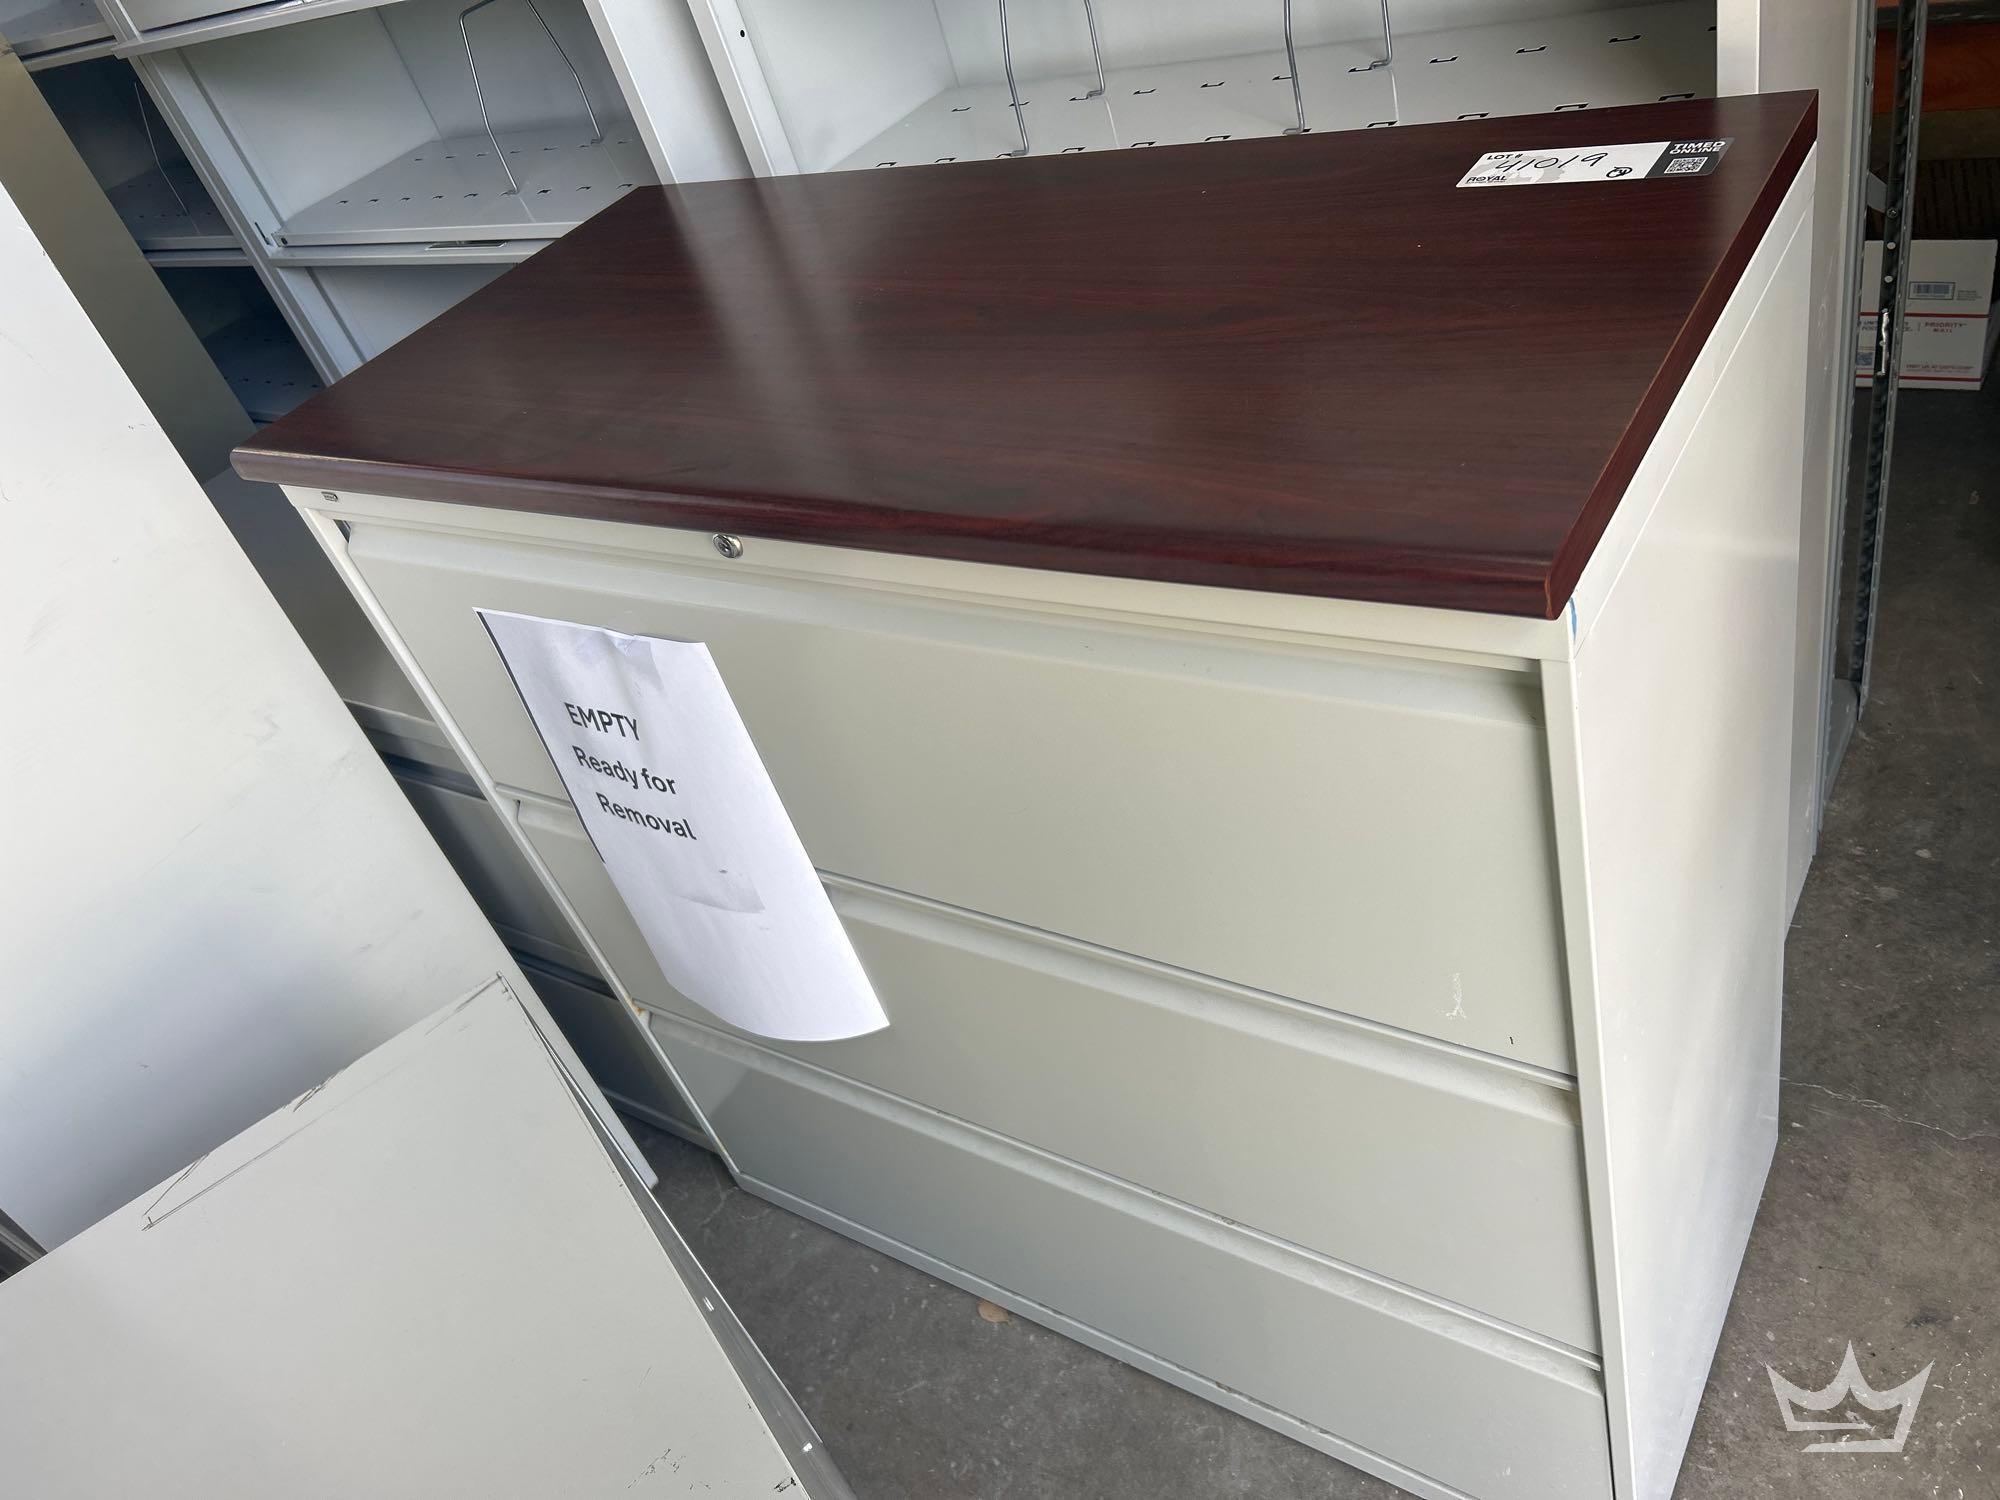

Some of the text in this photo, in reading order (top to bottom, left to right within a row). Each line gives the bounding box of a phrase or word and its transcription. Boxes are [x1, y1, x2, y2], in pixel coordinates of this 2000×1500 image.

[1669, 146, 1722, 155] ONLINE
[1673, 141, 1726, 150] TIMED
[1486, 153, 1514, 161] LOT
[1495, 152, 1608, 173] 41019
[1466, 175, 1507, 184] ROYAL
[564, 702, 640, 741] EMPTY
[571, 745, 677, 795] Ready for
[595, 791, 698, 841] Removal
